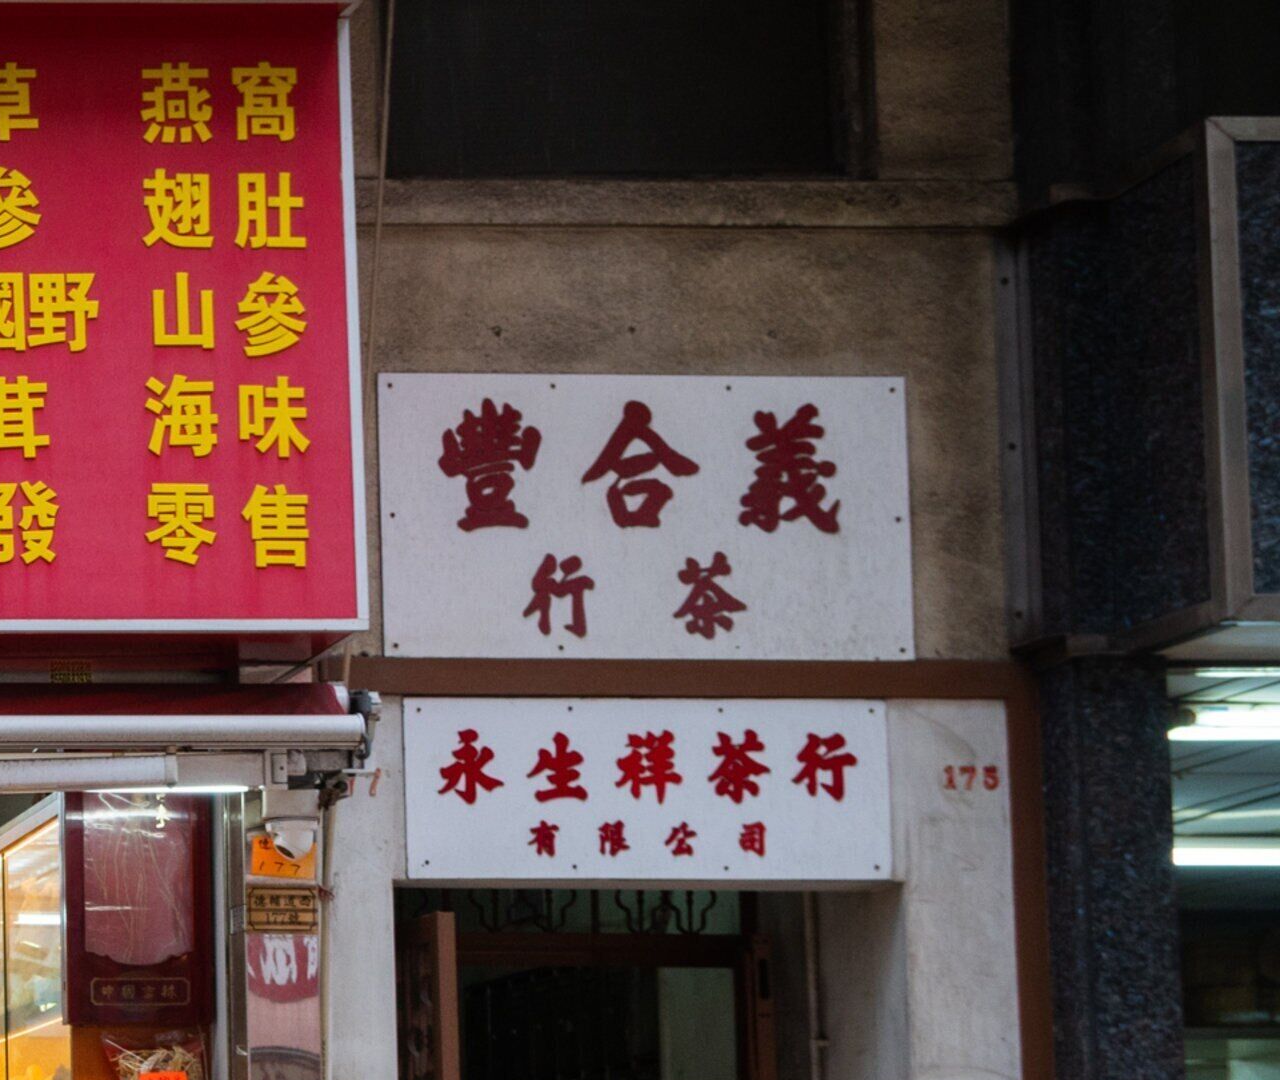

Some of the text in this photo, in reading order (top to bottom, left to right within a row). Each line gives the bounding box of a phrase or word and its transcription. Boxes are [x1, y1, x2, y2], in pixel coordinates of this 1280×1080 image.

[140, 61, 298, 144] 燕窩
[142, 168, 308, 250] 翅肚
[145, 374, 311, 459] 海味
[145, 482, 310, 568] 零售
[438, 728, 858, 805] 永生祥茶行
[943, 765, 1000, 792] 175
[528, 821, 768, 857] 有限公司
